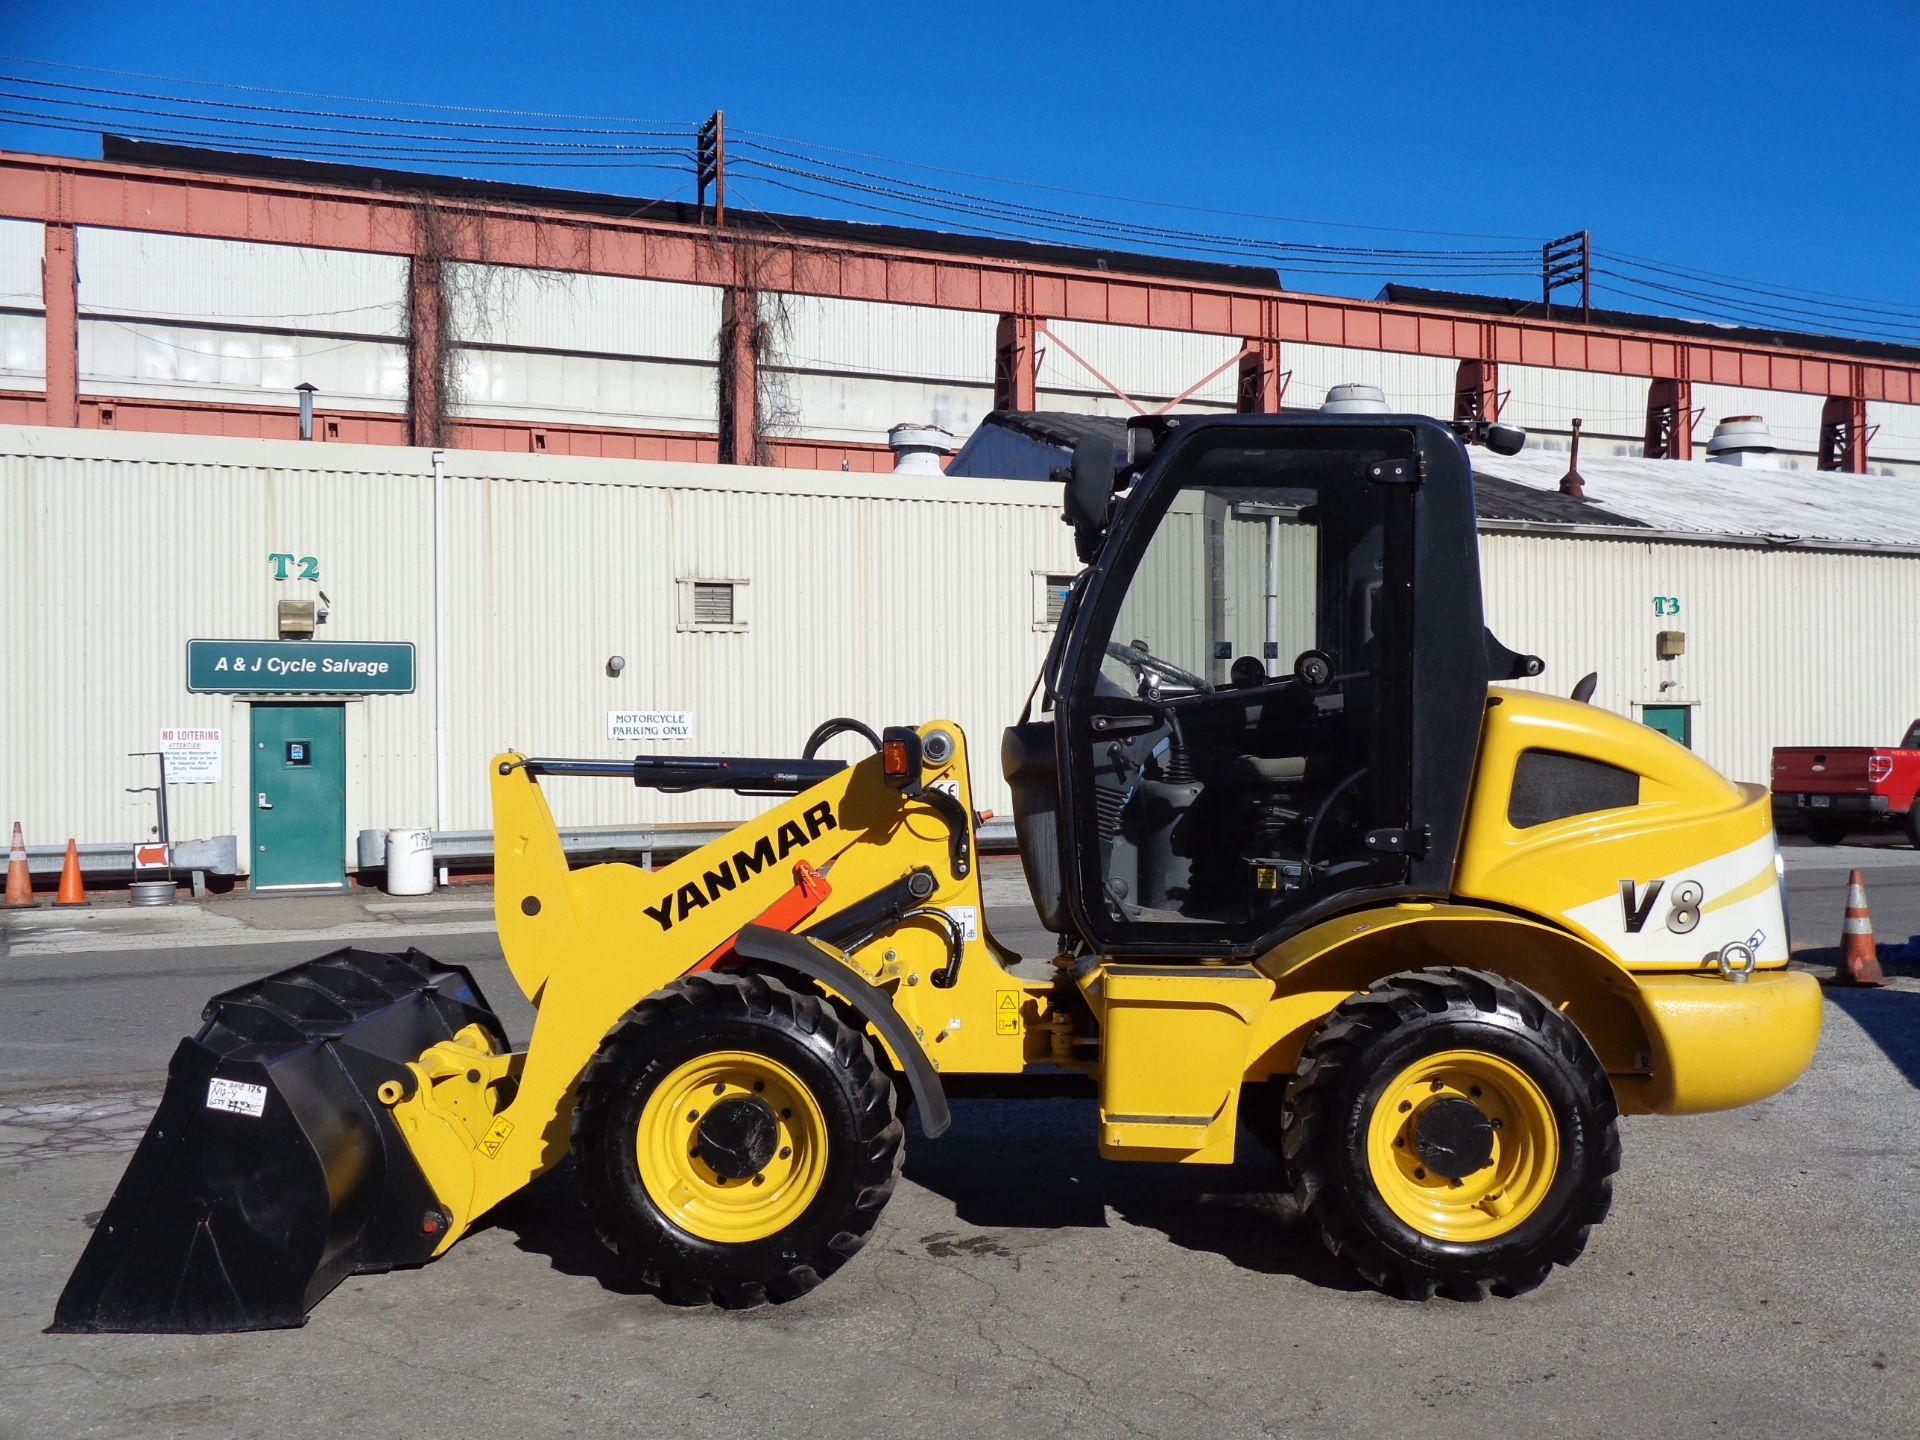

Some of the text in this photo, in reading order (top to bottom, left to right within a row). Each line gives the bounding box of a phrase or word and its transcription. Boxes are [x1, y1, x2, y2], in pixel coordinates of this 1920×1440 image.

[268, 553, 320, 579] T2
[1653, 596, 1680, 615] T3
[214, 656, 389, 677] A & J Cycle Salvage
[615, 714, 685, 724] MOTORCYCLE
[162, 730, 219, 741] NO LOITERING
[612, 726, 689, 735] PARKING ONLY
[642, 800, 838, 931] YANMAR
[1618, 879, 1704, 935] V8
